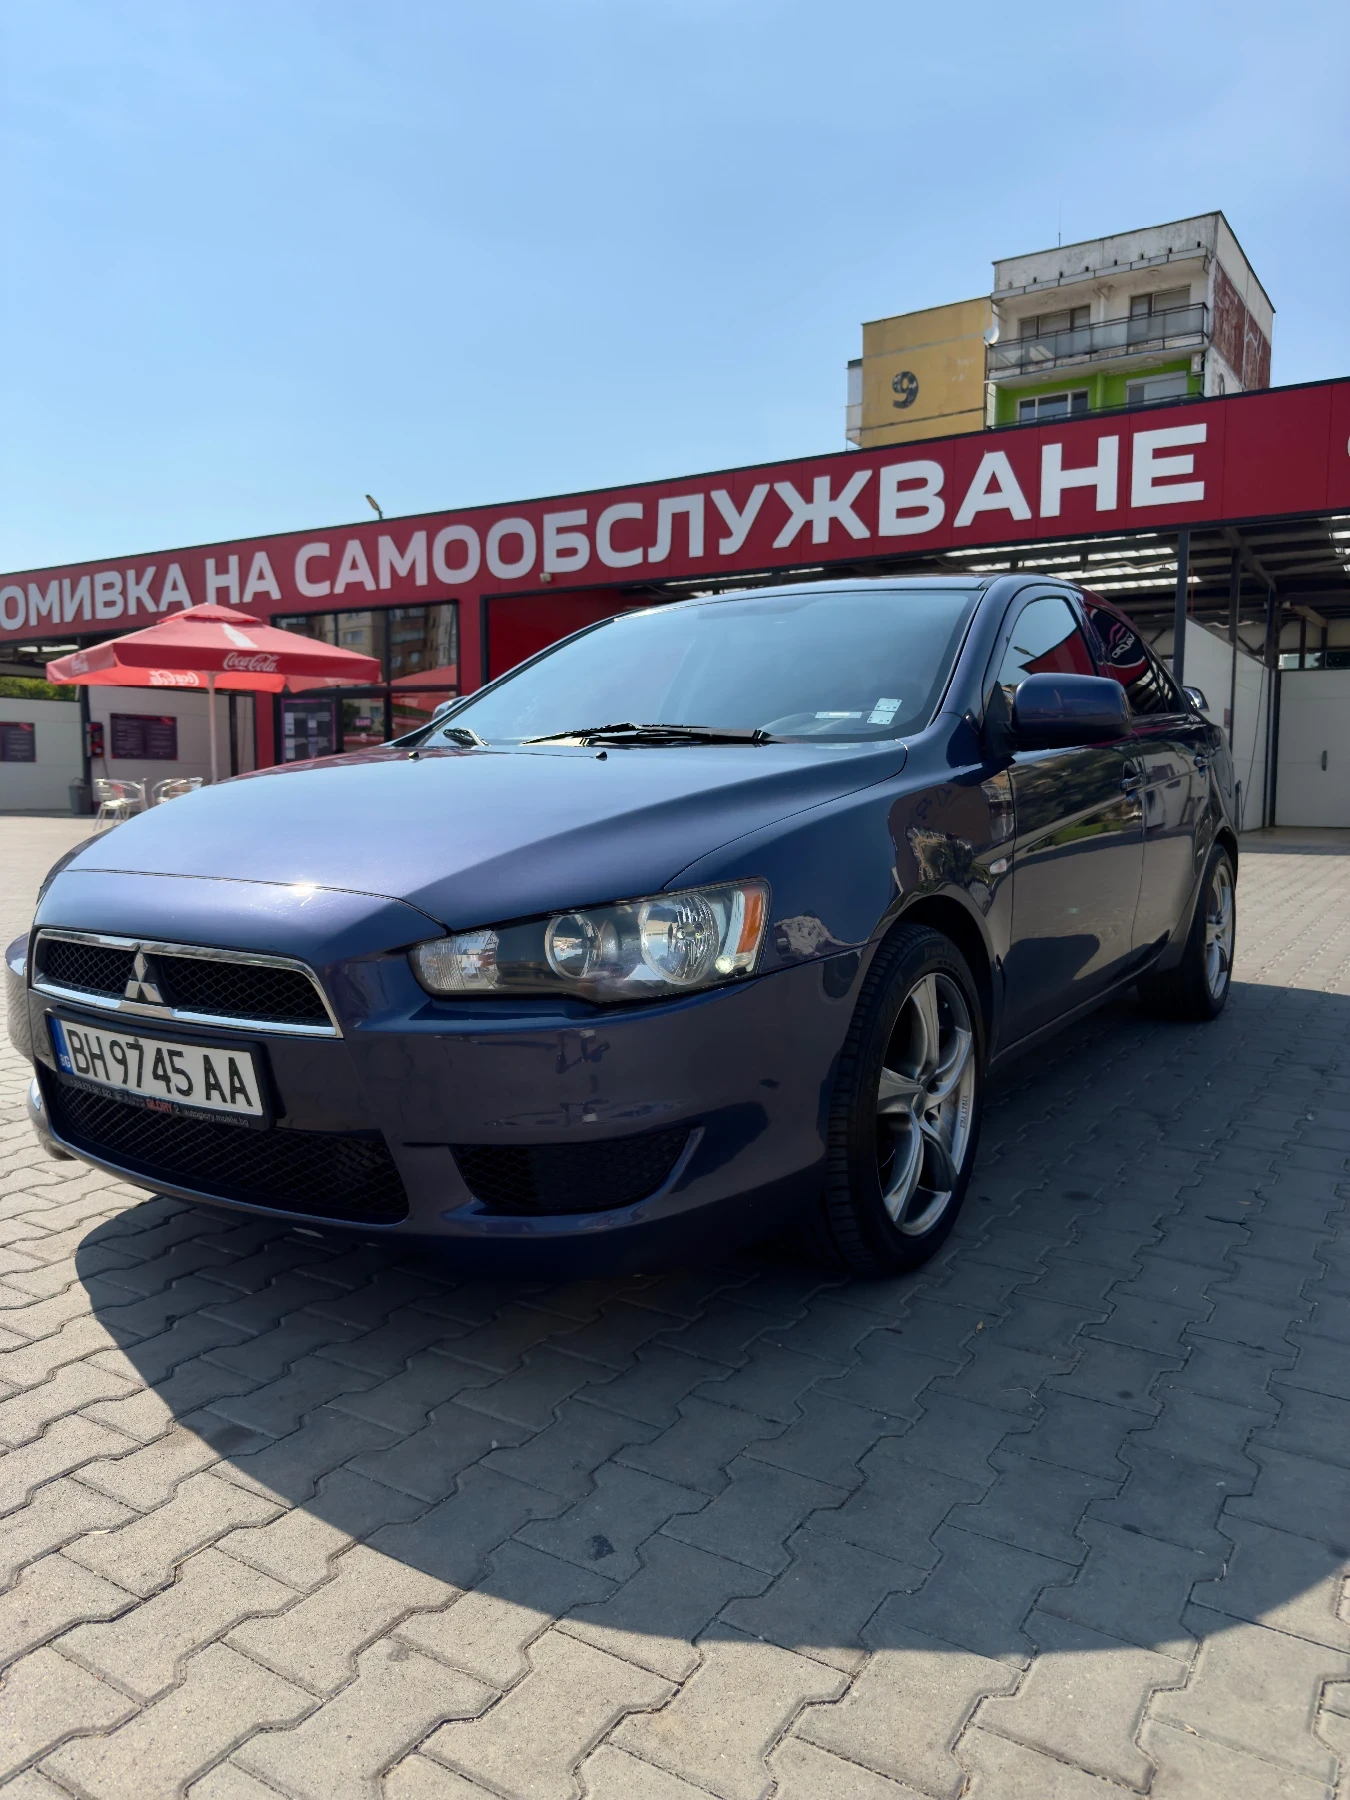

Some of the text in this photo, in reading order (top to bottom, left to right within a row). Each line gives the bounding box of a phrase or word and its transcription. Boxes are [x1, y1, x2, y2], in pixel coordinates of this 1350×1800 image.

[892, 371, 919, 409] 9
[0, 423, 1207, 630] ОМИВКА НА САМООБСЛУЖВАНЕ
[60, 1053, 71, 1068] BG
[203, 1054, 253, 1107] AA
[145, 1098, 173, 1113] GLORY
